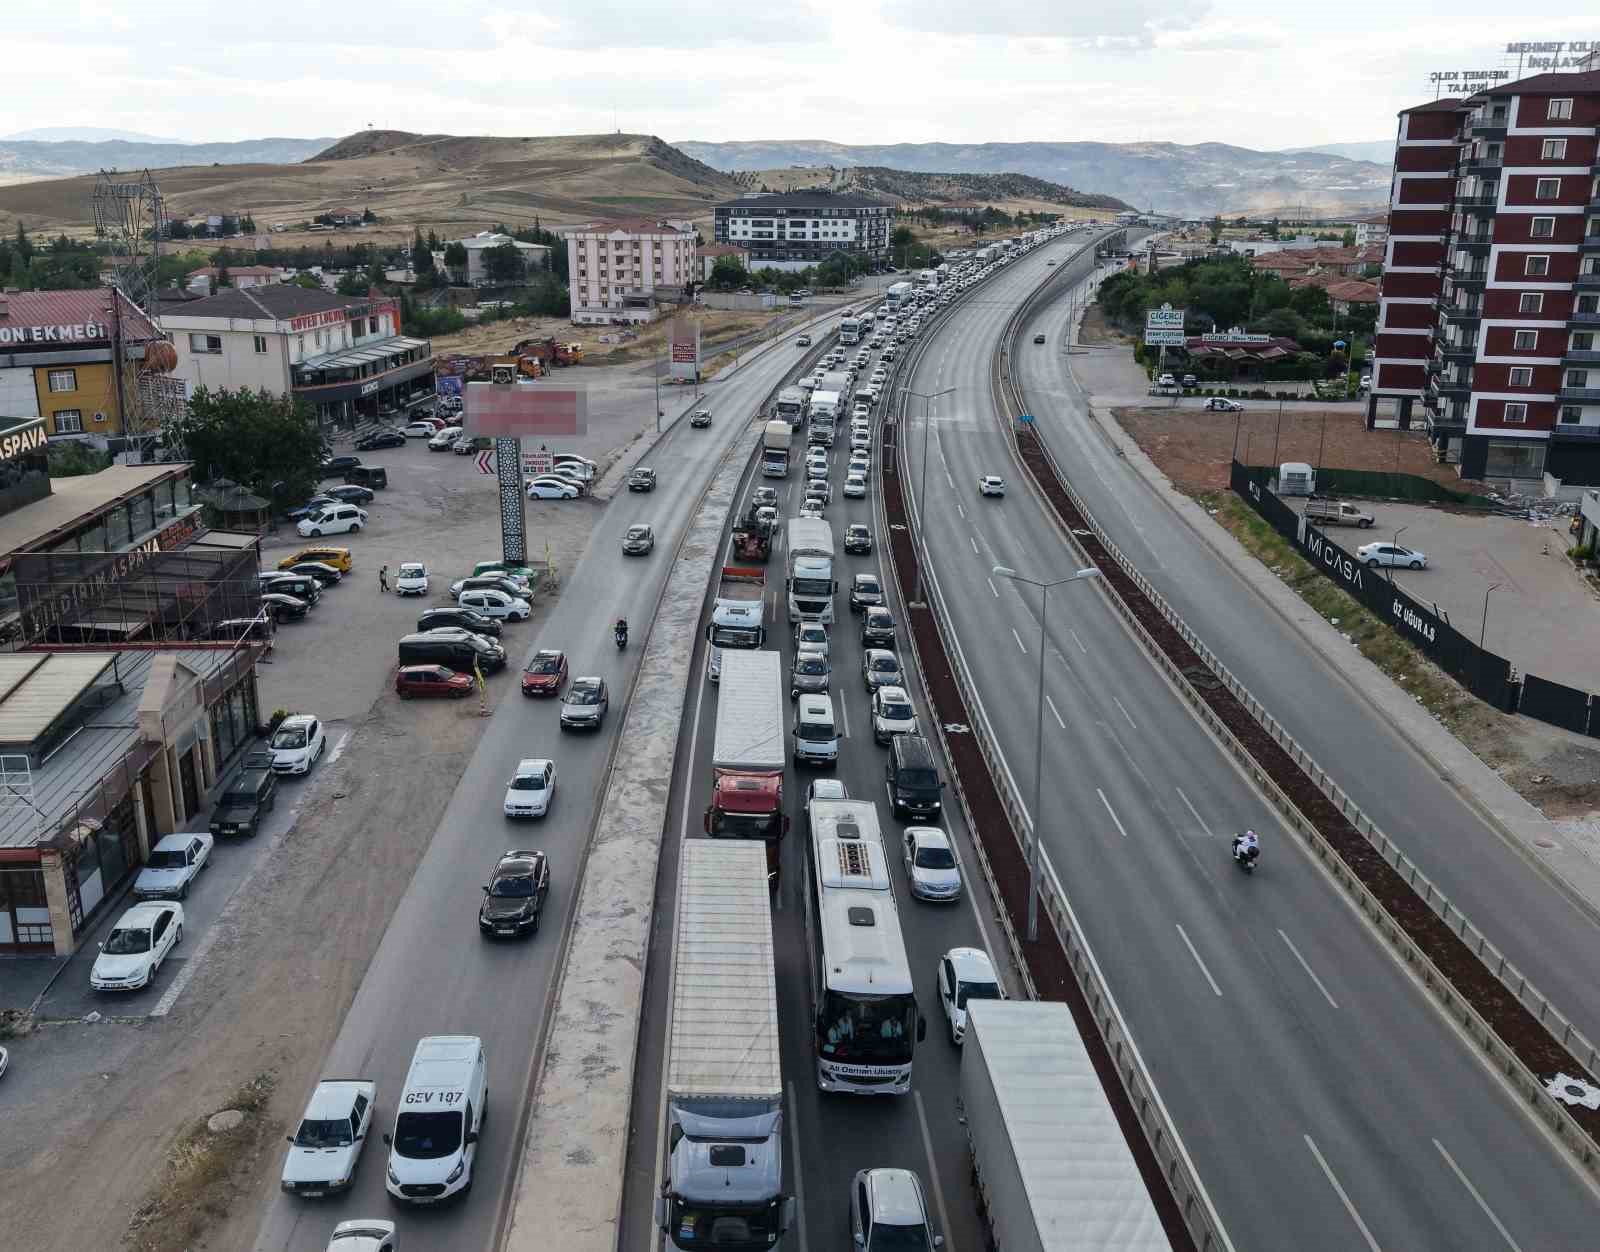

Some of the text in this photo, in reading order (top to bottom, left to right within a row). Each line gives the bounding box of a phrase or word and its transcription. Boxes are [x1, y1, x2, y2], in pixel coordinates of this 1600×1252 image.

[1506, 41, 1565, 53] MEHMET
[31, 320, 104, 341] EKMEĞİ
[1324, 547, 1363, 589] CASA
